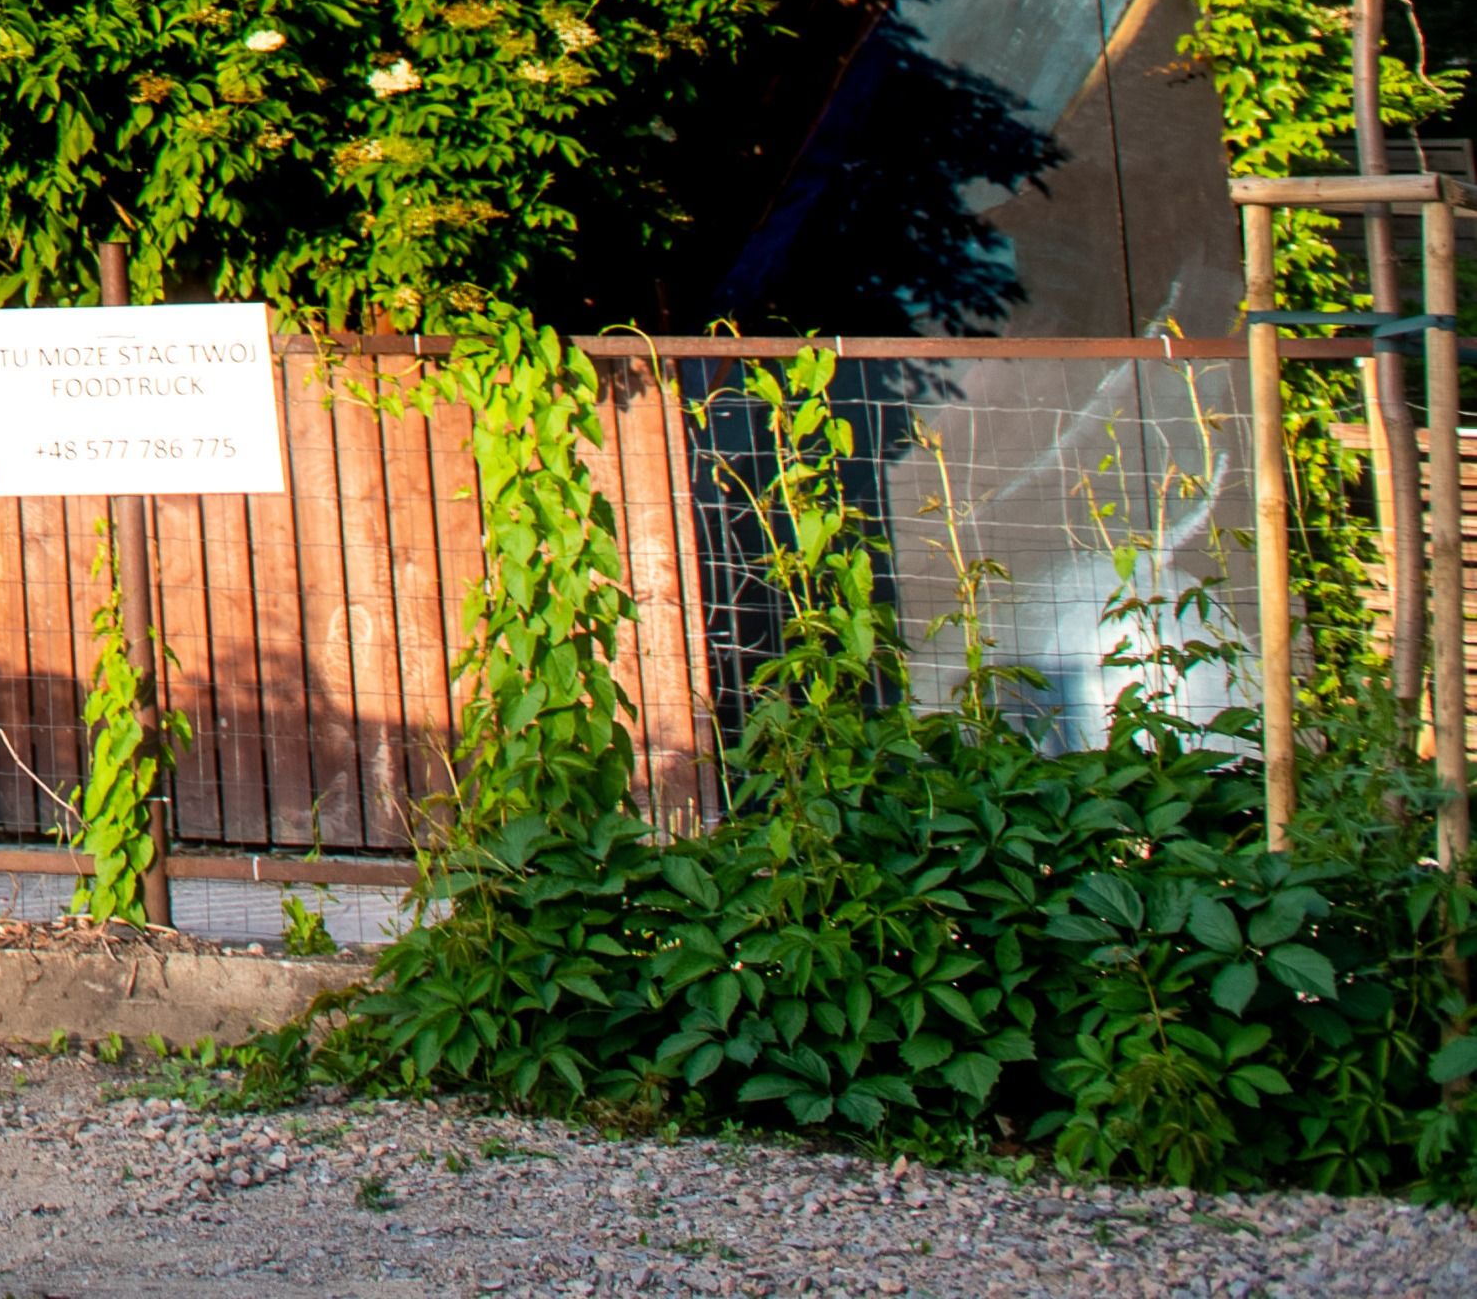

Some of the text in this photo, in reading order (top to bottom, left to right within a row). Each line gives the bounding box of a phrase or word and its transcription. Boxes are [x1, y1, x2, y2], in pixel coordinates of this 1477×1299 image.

[51, 375, 205, 398] FOODTRUCK
[35, 437, 238, 460] +48 577 786 775
